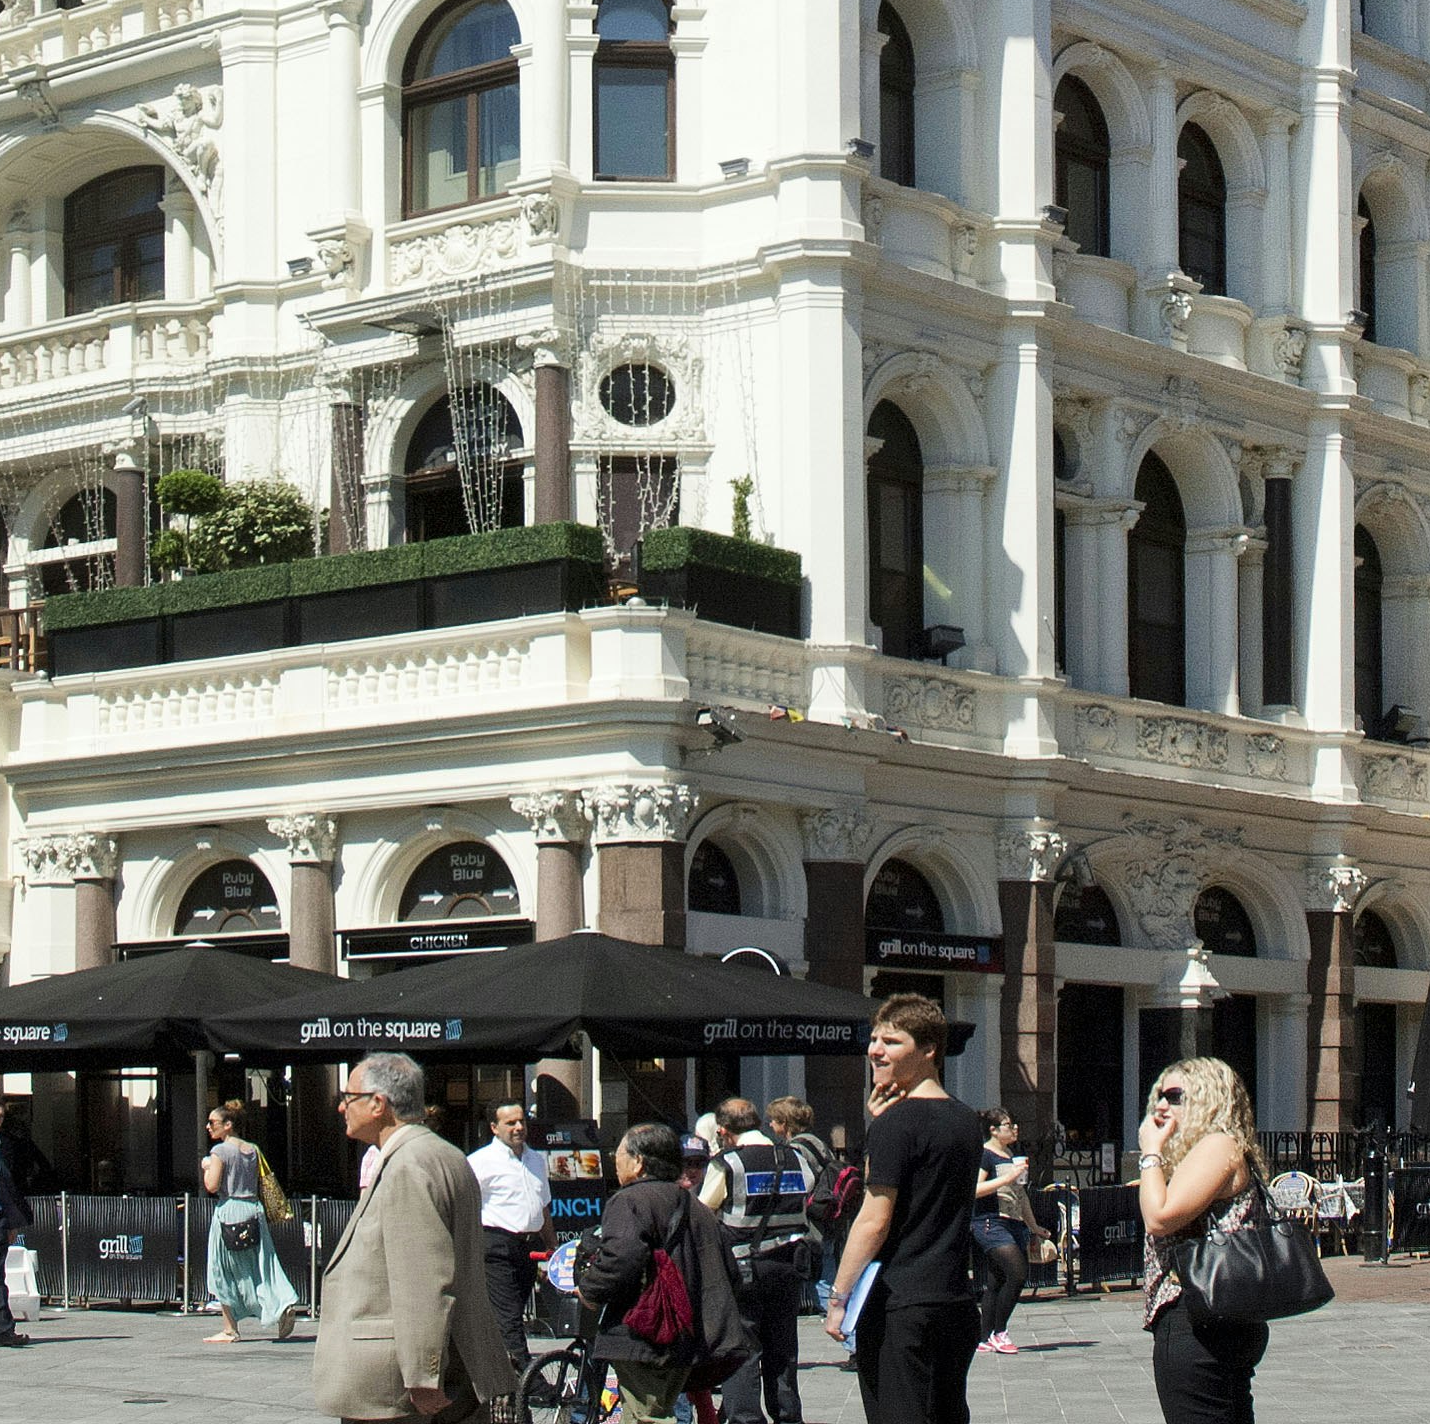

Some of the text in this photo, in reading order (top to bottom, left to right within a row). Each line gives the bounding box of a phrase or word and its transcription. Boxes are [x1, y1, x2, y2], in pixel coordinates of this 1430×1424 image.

[450, 854, 485, 868] Ruby
[222, 872, 254, 886] Ruby
[453, 868, 483, 881] Blue
[224, 886, 252, 899] Blue
[410, 934, 468, 950] CHICKEN
[879, 939, 976, 961] grill on the square
[3, 1025, 51, 1045] square
[301, 1017, 441, 1044] grill on the square
[703, 1019, 852, 1045] grill on the square
[551, 1197, 601, 1217] UNCH
[1104, 1221, 1127, 1245] grill
[99, 1234, 128, 1259] grill
